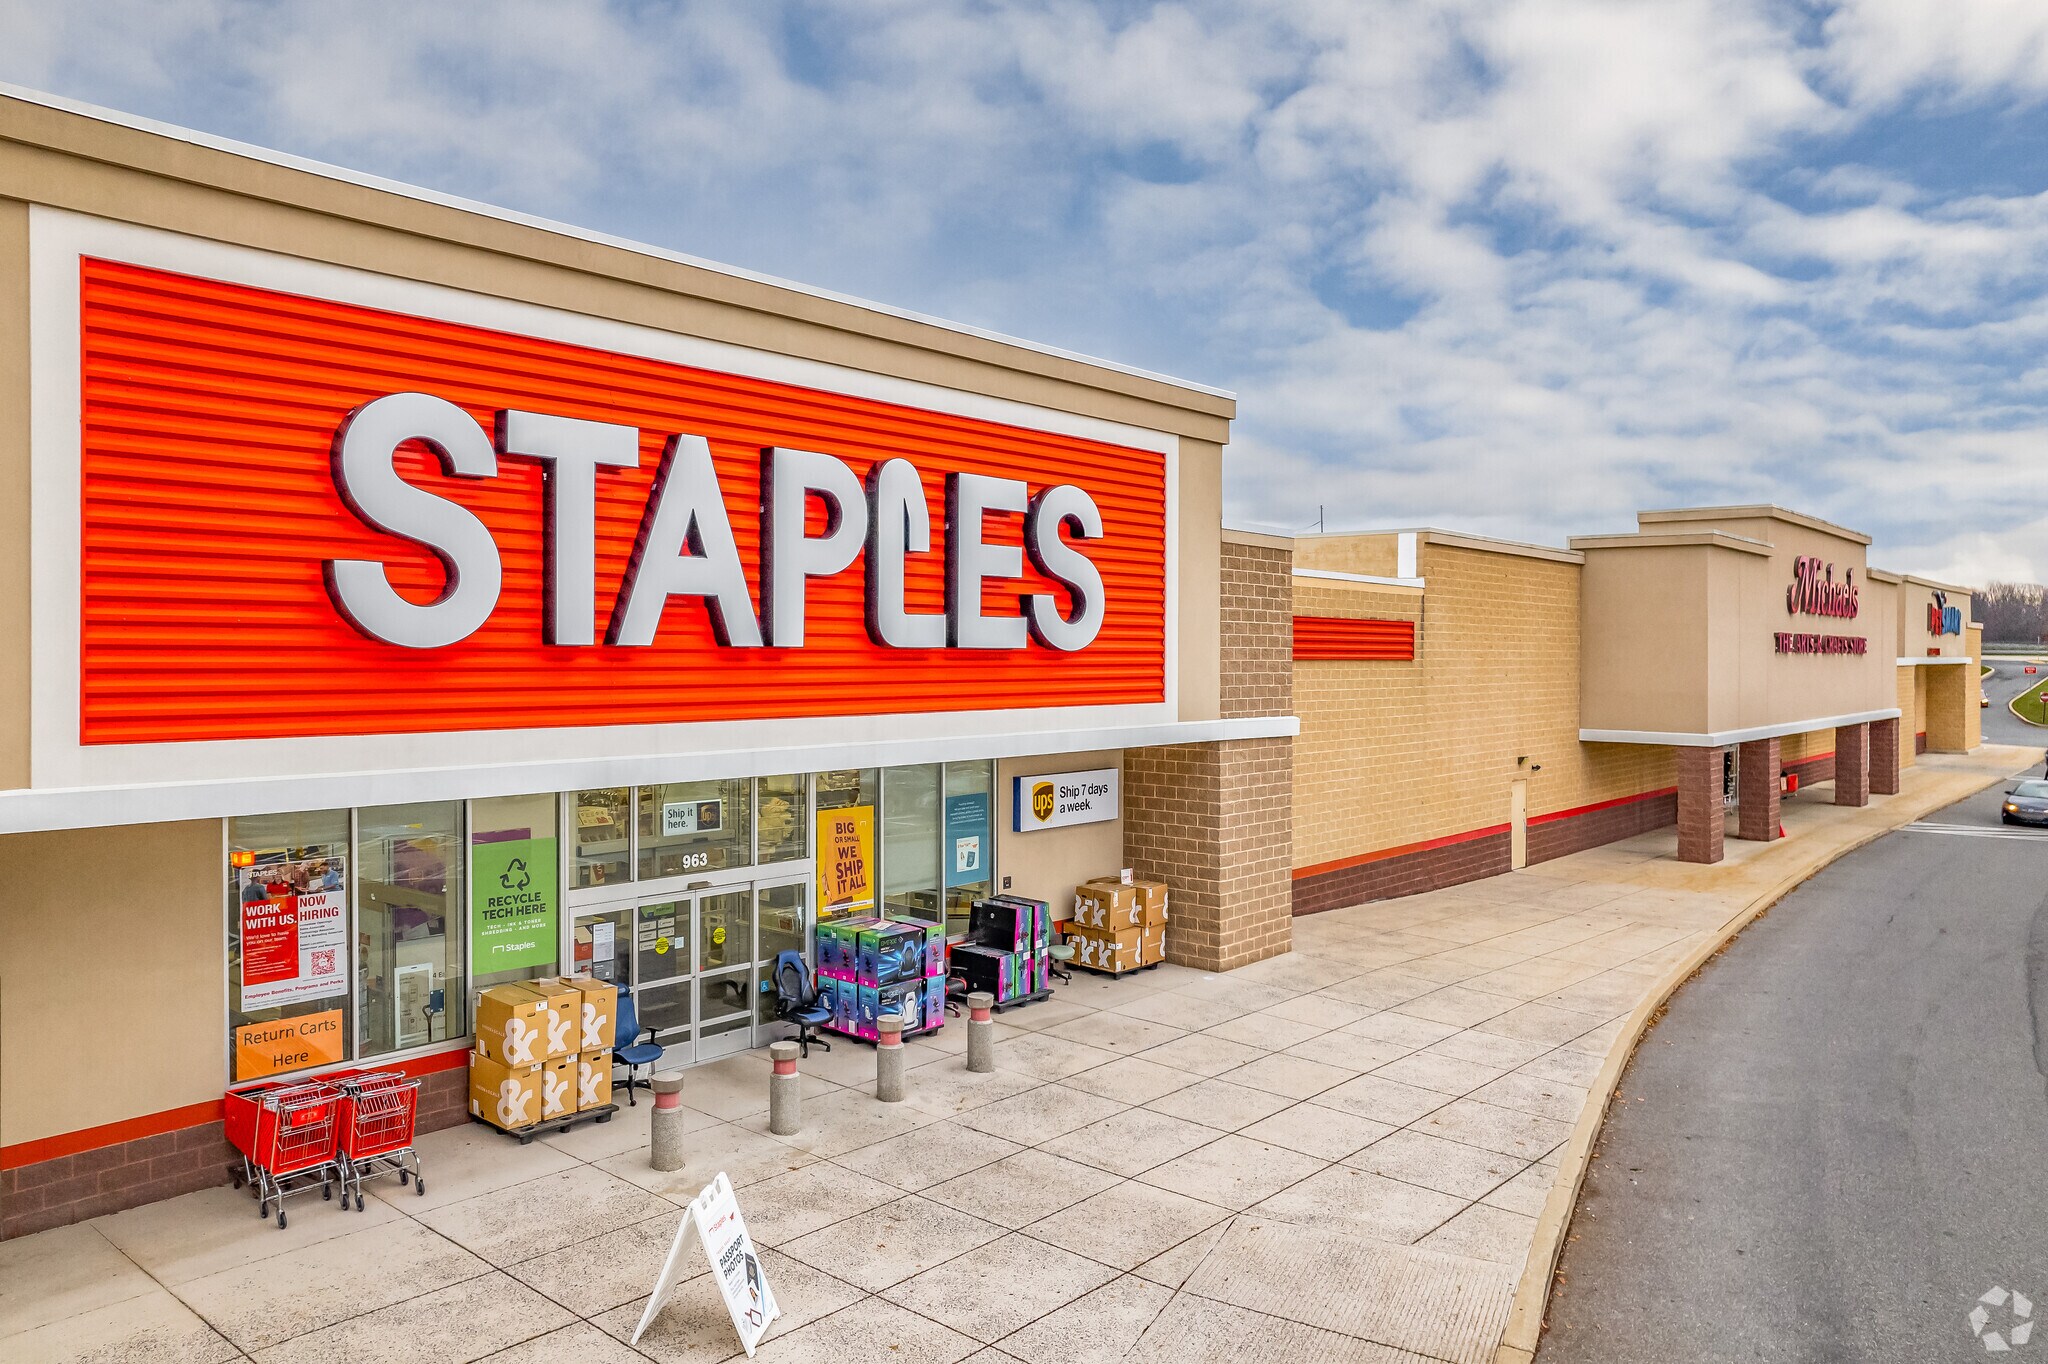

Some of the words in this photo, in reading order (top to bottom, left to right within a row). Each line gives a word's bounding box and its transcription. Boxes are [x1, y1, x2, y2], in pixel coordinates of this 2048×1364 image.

[324, 392, 1106, 651] STAPLES
[1787, 555, 1859, 619] Michaels
[1774, 632, 1793, 653] THE
[1794, 633, 1815, 654] ARTS
[1823, 635, 1849, 654] CRAFTS
[1849, 636, 1867, 655] STORE
[1034, 793, 1053, 816] ups
[1059, 785, 1080, 799] Ship
[1081, 784, 1087, 796] 7
[1087, 783, 1109, 796] days
[1059, 804, 1066, 813] a
[1067, 799, 1093, 812] week.
[667, 808, 685, 820] Ship
[687, 806, 694, 817] it
[667, 819, 689, 829] here.
[835, 821, 855, 835] BIG
[834, 836, 844, 844] OR
[844, 835, 860, 843] SMALL
[682, 852, 708, 869] 963
[838, 845, 857, 860] WE
[835, 859, 864, 880] SHIP
[837, 879, 847, 895] IT
[849, 875, 867, 891] ALL
[299, 895, 327, 908] NOW
[488, 892, 542, 908] RECYCLE
[245, 903, 281, 917] WORK
[299, 906, 339, 922] HIRING
[482, 907, 513, 920] TECH
[516, 903, 546, 916] HERE
[245, 916, 276, 930] WITH
[278, 914, 298, 925] US.
[481, 927, 513, 936] SHREDDING
[505, 941, 536, 952] Staples
[244, 990, 270, 999] Employee
[294, 983, 319, 991] Programs
[244, 1028, 295, 1046] Return
[299, 1020, 337, 1036] Carts
[273, 1051, 309, 1068] Here
[719, 1234, 745, 1269] PASSPORT
[723, 1250, 744, 1280] PHOTOS
